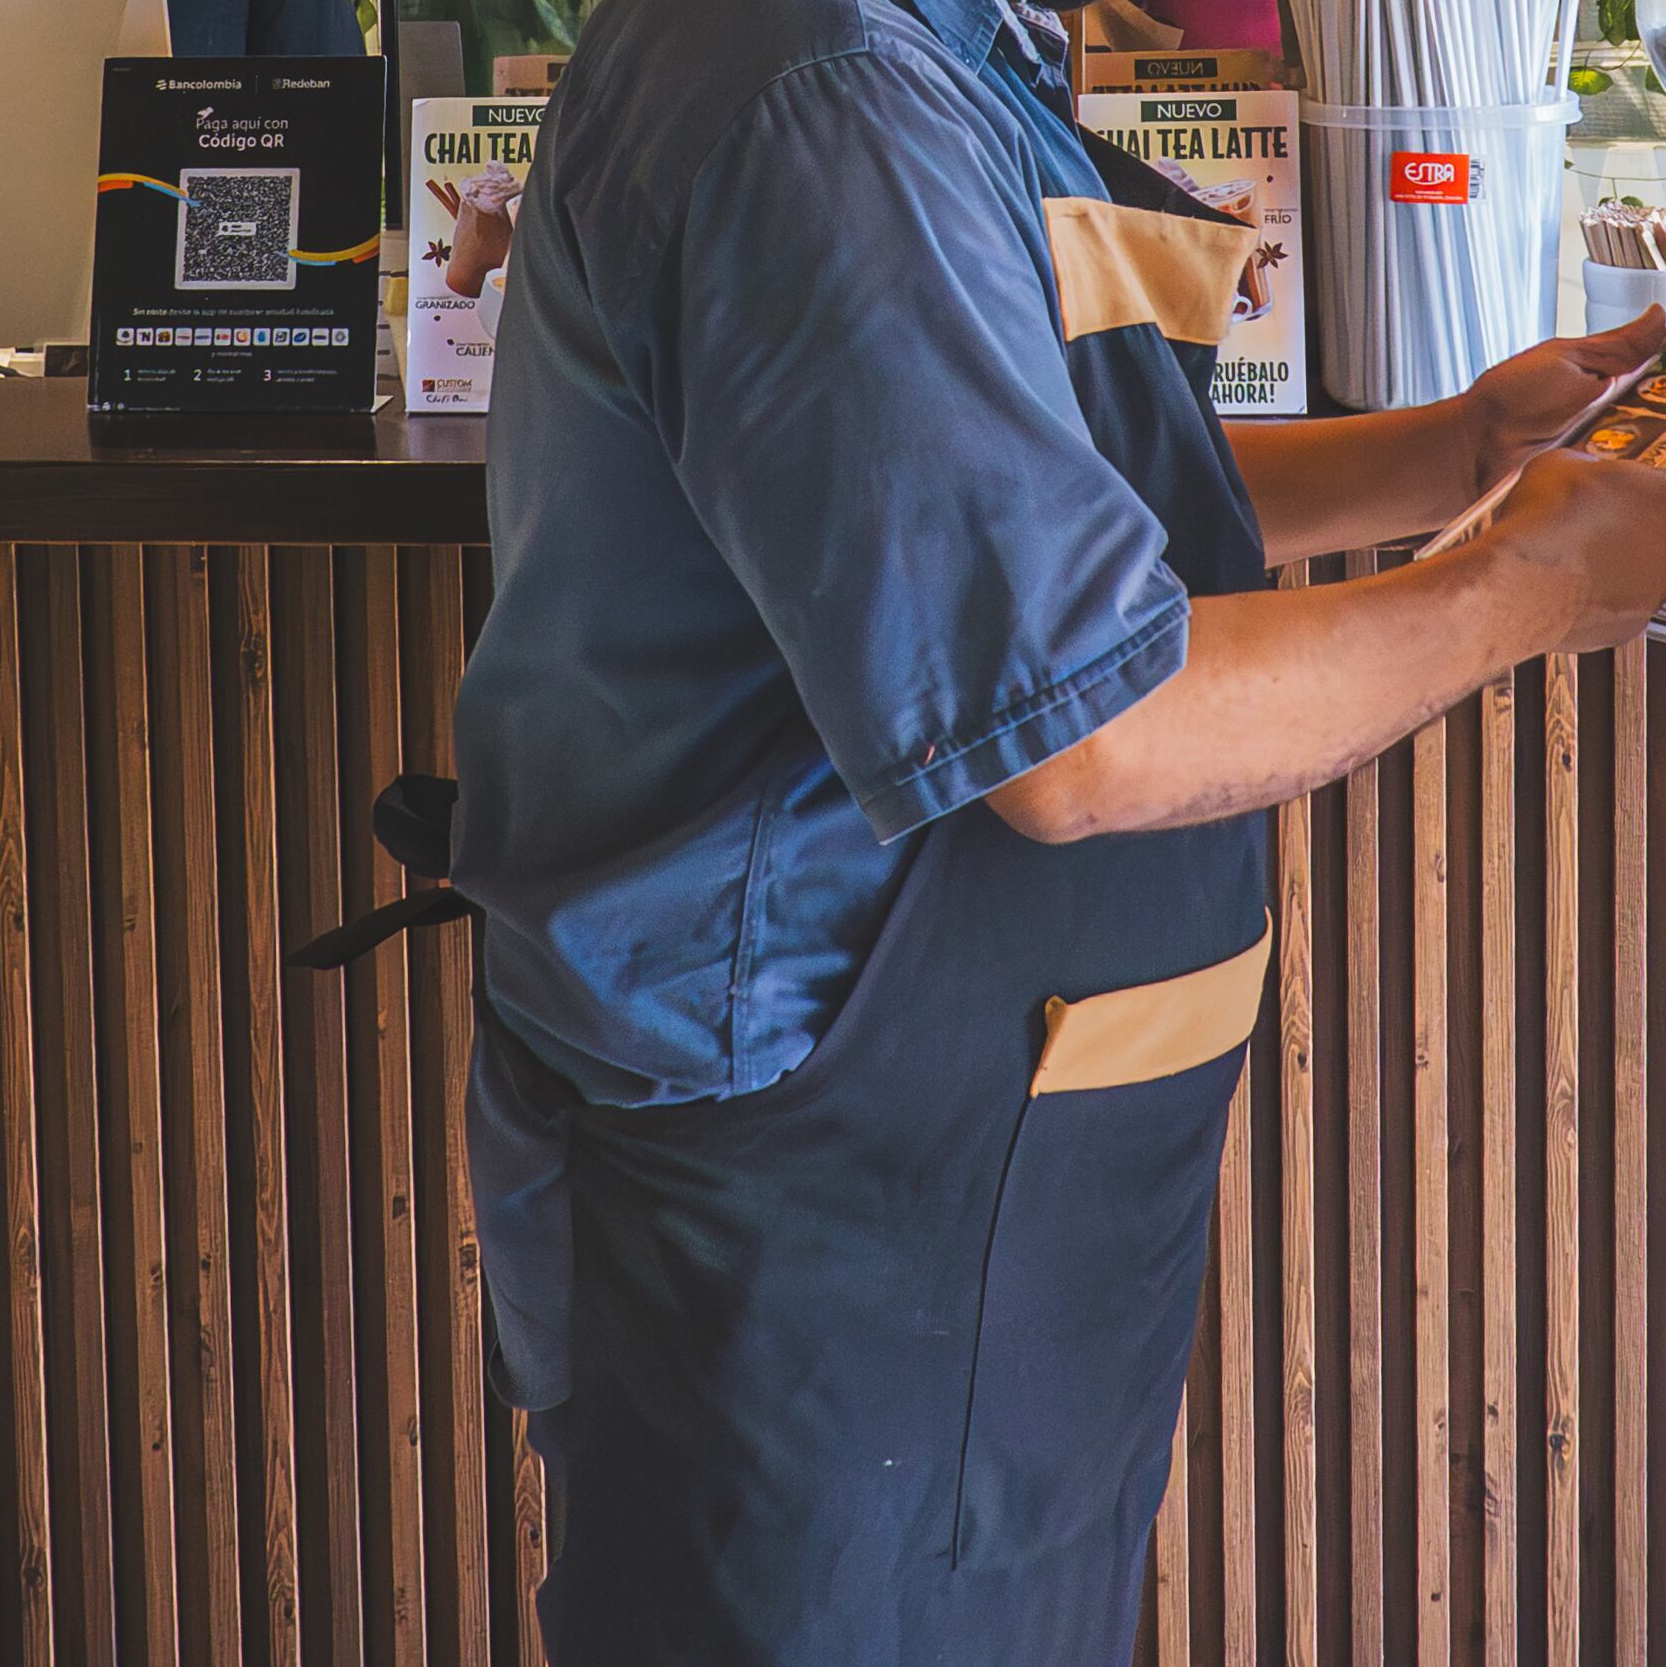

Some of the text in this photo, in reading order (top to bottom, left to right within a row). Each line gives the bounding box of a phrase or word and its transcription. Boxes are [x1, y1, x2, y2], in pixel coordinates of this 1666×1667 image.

[168, 79, 242, 91] Bancolombia
[1157, 102, 1223, 119] NUEVO
[196, 116, 289, 133] Paga aquí con
[199, 133, 284, 151] Código QR
[424, 133, 532, 164] CHAI TEA
[1156, 128, 1205, 159] TEA
[1212, 126, 1288, 159] LATTE
[1404, 162, 1455, 185] ESTRA
[415, 300, 476, 310] GRANIZADO
[124, 369, 132, 382] 1
[193, 369, 202, 382] 2
[263, 369, 272, 382] 3
[1214, 357, 1289, 383] RUÉBALO
[1211, 383, 1275, 404] AHORA!
